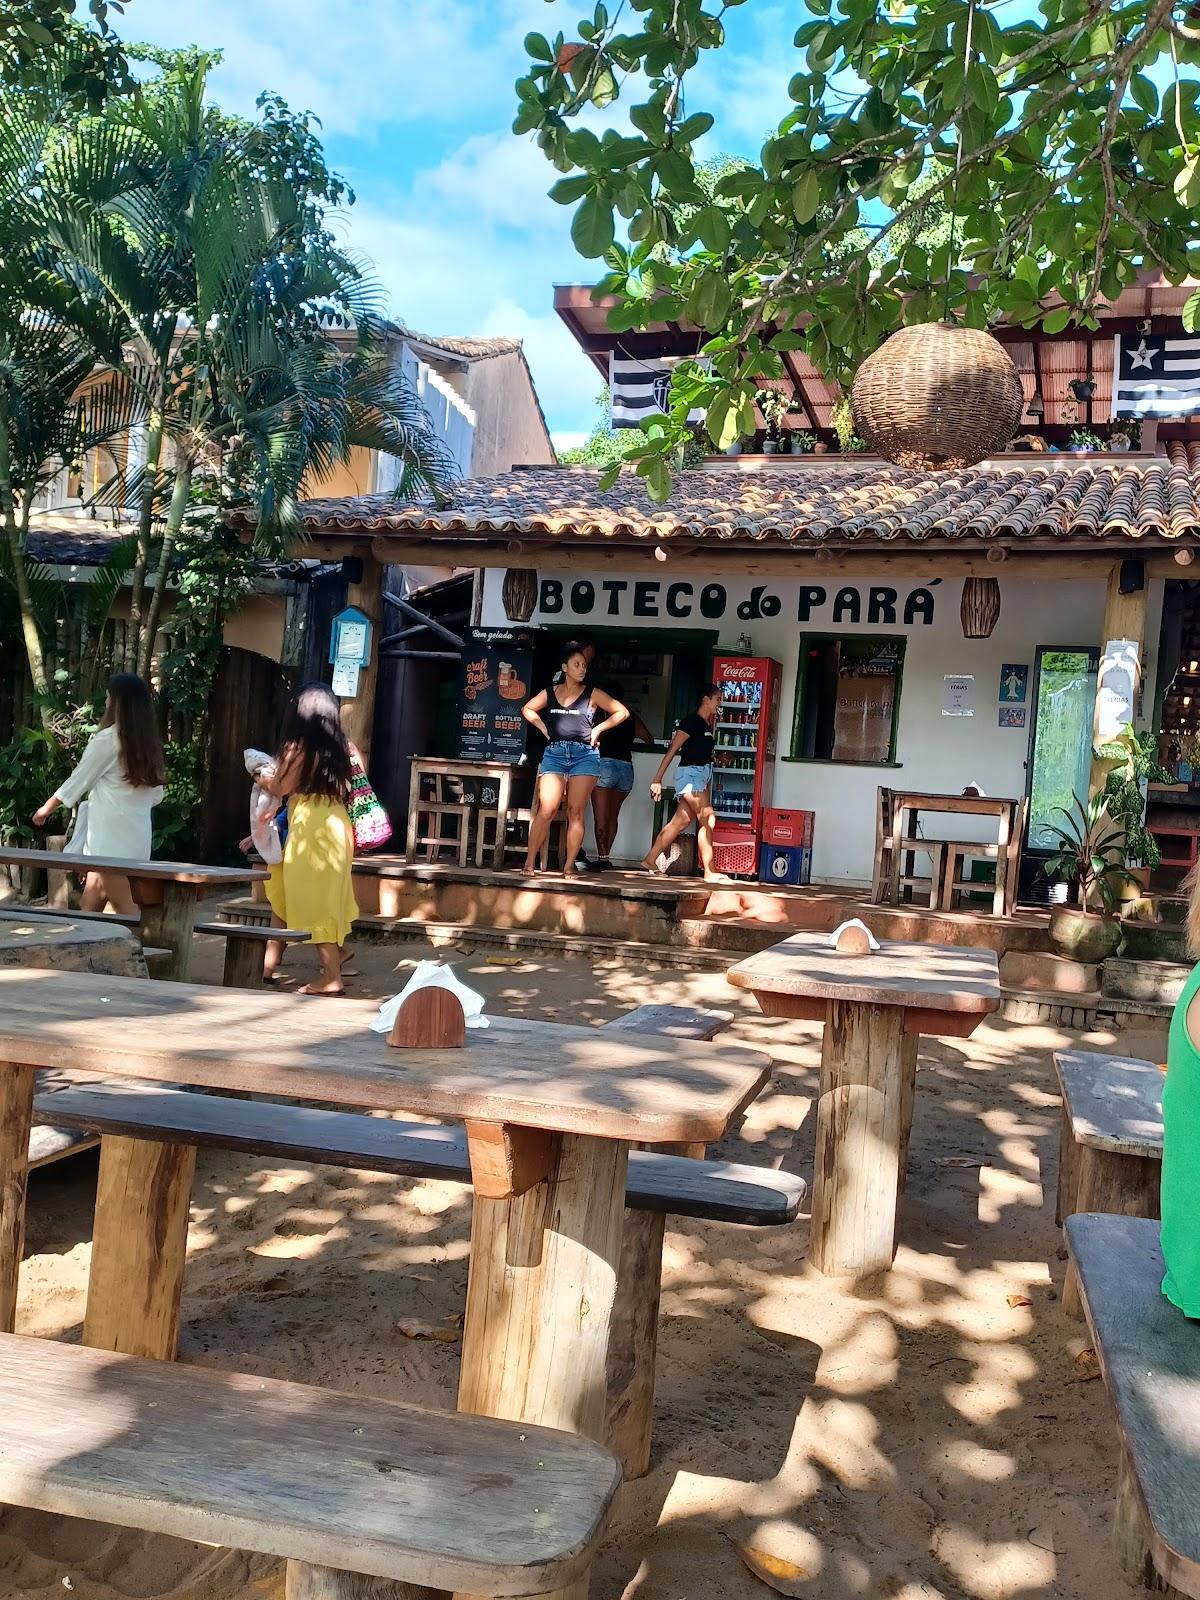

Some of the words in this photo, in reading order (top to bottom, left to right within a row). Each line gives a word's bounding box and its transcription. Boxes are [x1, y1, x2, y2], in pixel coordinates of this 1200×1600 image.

[540, 579, 727, 618] BOTECO
[736, 585, 782, 620] do
[798, 577, 943, 624] PARÁ
[472, 629, 487, 637] Bem
[488, 630, 513, 641] gelada
[462, 720, 486, 728] BEER
[495, 721, 522, 730] BEER
